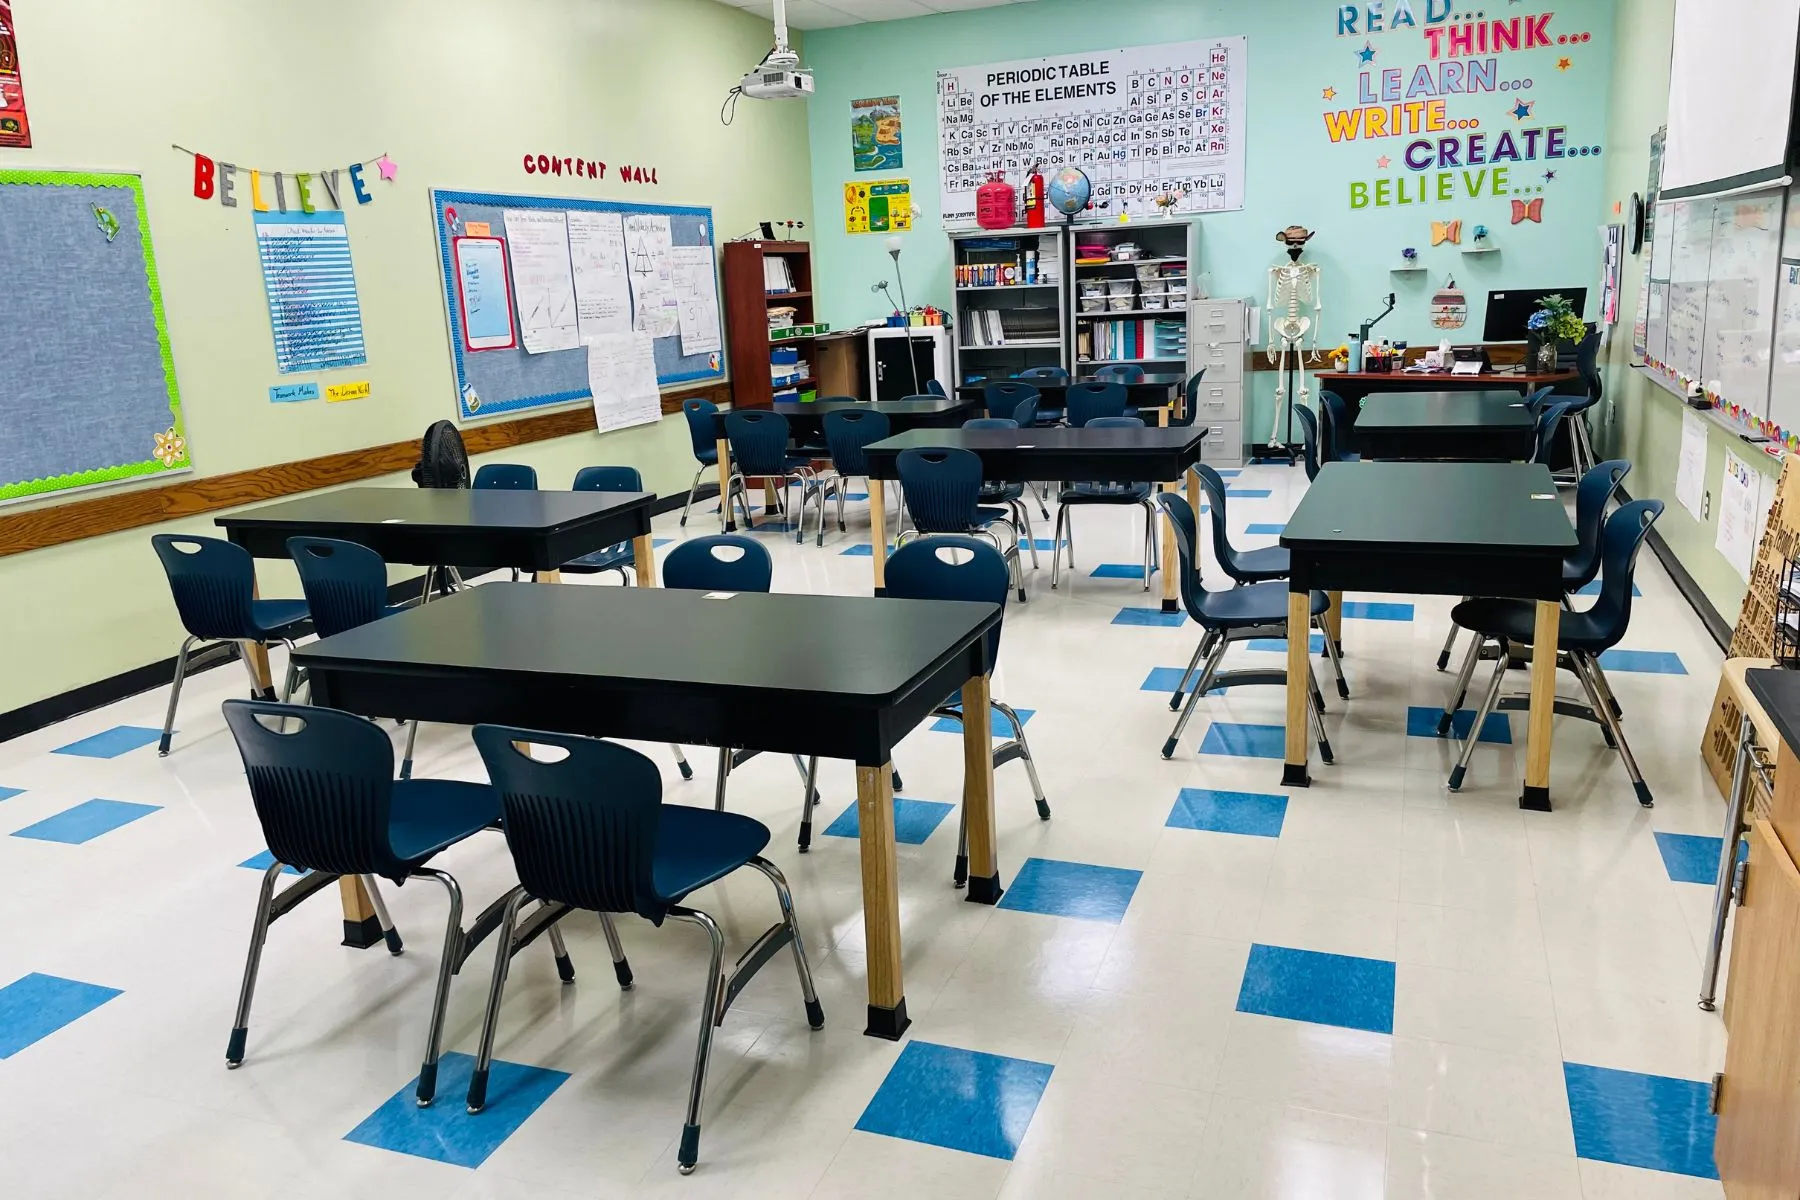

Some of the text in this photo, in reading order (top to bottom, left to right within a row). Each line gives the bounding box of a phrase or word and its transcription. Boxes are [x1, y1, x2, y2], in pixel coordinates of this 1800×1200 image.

[1337, 0, 1484, 38] READ...
[1424, 12, 1591, 60] THINK...
[987, 61, 1109, 86] PERIODIC TABLE
[1212, 54, 1225, 63] He
[947, 82, 954, 91] H
[980, 81, 1116, 107] OF THE ELEMENTS
[1132, 72, 1225, 88] B C N O F Ne
[1359, 58, 1533, 104] LEARN...
[947, 97, 972, 107] Li Be
[1130, 89, 1224, 106] Al Si P S Cl Ar
[946, 114, 973, 124] Na Mg
[961, 130, 973, 139] Ca
[976, 129, 987, 137] Sc
[1008, 126, 1015, 134] V
[1021, 124, 1032, 133] Cr
[1035, 123, 1048, 132] Mn
[1051, 122, 1062, 130] Fe
[1066, 120, 1078, 129] Co
[1083, 118, 1093, 127] Ni
[1097, 117, 1110, 126] Cu
[1113, 116, 1125, 125] Zn
[1129, 114, 1142, 123] Ga
[1145, 113, 1158, 122] Ge
[1162, 112, 1175, 120] As
[1178, 110, 1191, 119] Se
[1196, 109, 1207, 117] Br
[1212, 107, 1223, 115] Kr
[1324, 99, 1479, 143] WRITE...
[947, 148, 959, 156] Rb
[963, 147, 972, 155] Sr
[979, 145, 985, 153] Y
[992, 144, 1001, 152] Zr
[1005, 143, 1018, 151] Nb
[1020, 141, 1033, 150] Mo
[1051, 139, 1063, 147] Ru
[1066, 138, 1078, 146] Rh
[1082, 136, 1094, 144] Pd
[1097, 135, 1110, 144] Ag
[1113, 133, 1126, 142] Cd
[1131, 132, 1140, 140] In
[1145, 130, 1157, 139] Sn
[1161, 129, 1174, 138] Sb
[1178, 127, 1190, 136] Te
[1211, 124, 1224, 133] Xe
[1404, 125, 1601, 171] CREATE...
[523, 154, 658, 185] CONTENT WALL
[947, 164, 959, 172] Cs
[962, 163, 974, 171] Ba
[993, 160, 1002, 168] Hf
[1007, 159, 1017, 167] Ta
[1023, 158, 1031, 166] W
[1051, 155, 1063, 163] Os
[1069, 154, 1076, 162] Ir
[1084, 153, 1093, 161] Pt
[1097, 152, 1110, 160] Au
[1113, 150, 1126, 159] Hg
[1145, 147, 1158, 156] Pb
[1163, 146, 1172, 154] Bi
[1178, 145, 1190, 153] Po
[1195, 143, 1206, 152] At
[1211, 142, 1224, 151] Rn
[193, 152, 373, 214] BELIEVE
[950, 180, 959, 188] Fr
[963, 179, 974, 187] Ra
[1097, 187, 1110, 196] Gd
[1114, 186, 1125, 194] Tb
[1129, 185, 1141, 194] Dy
[1145, 184, 1157, 192] Ho
[1162, 183, 1172, 191] Er
[1176, 182, 1191, 190] Tm
[1193, 180, 1206, 188] Yb
[1210, 179, 1223, 187] Lu
[1349, 166, 1544, 209] BELIEVE...
